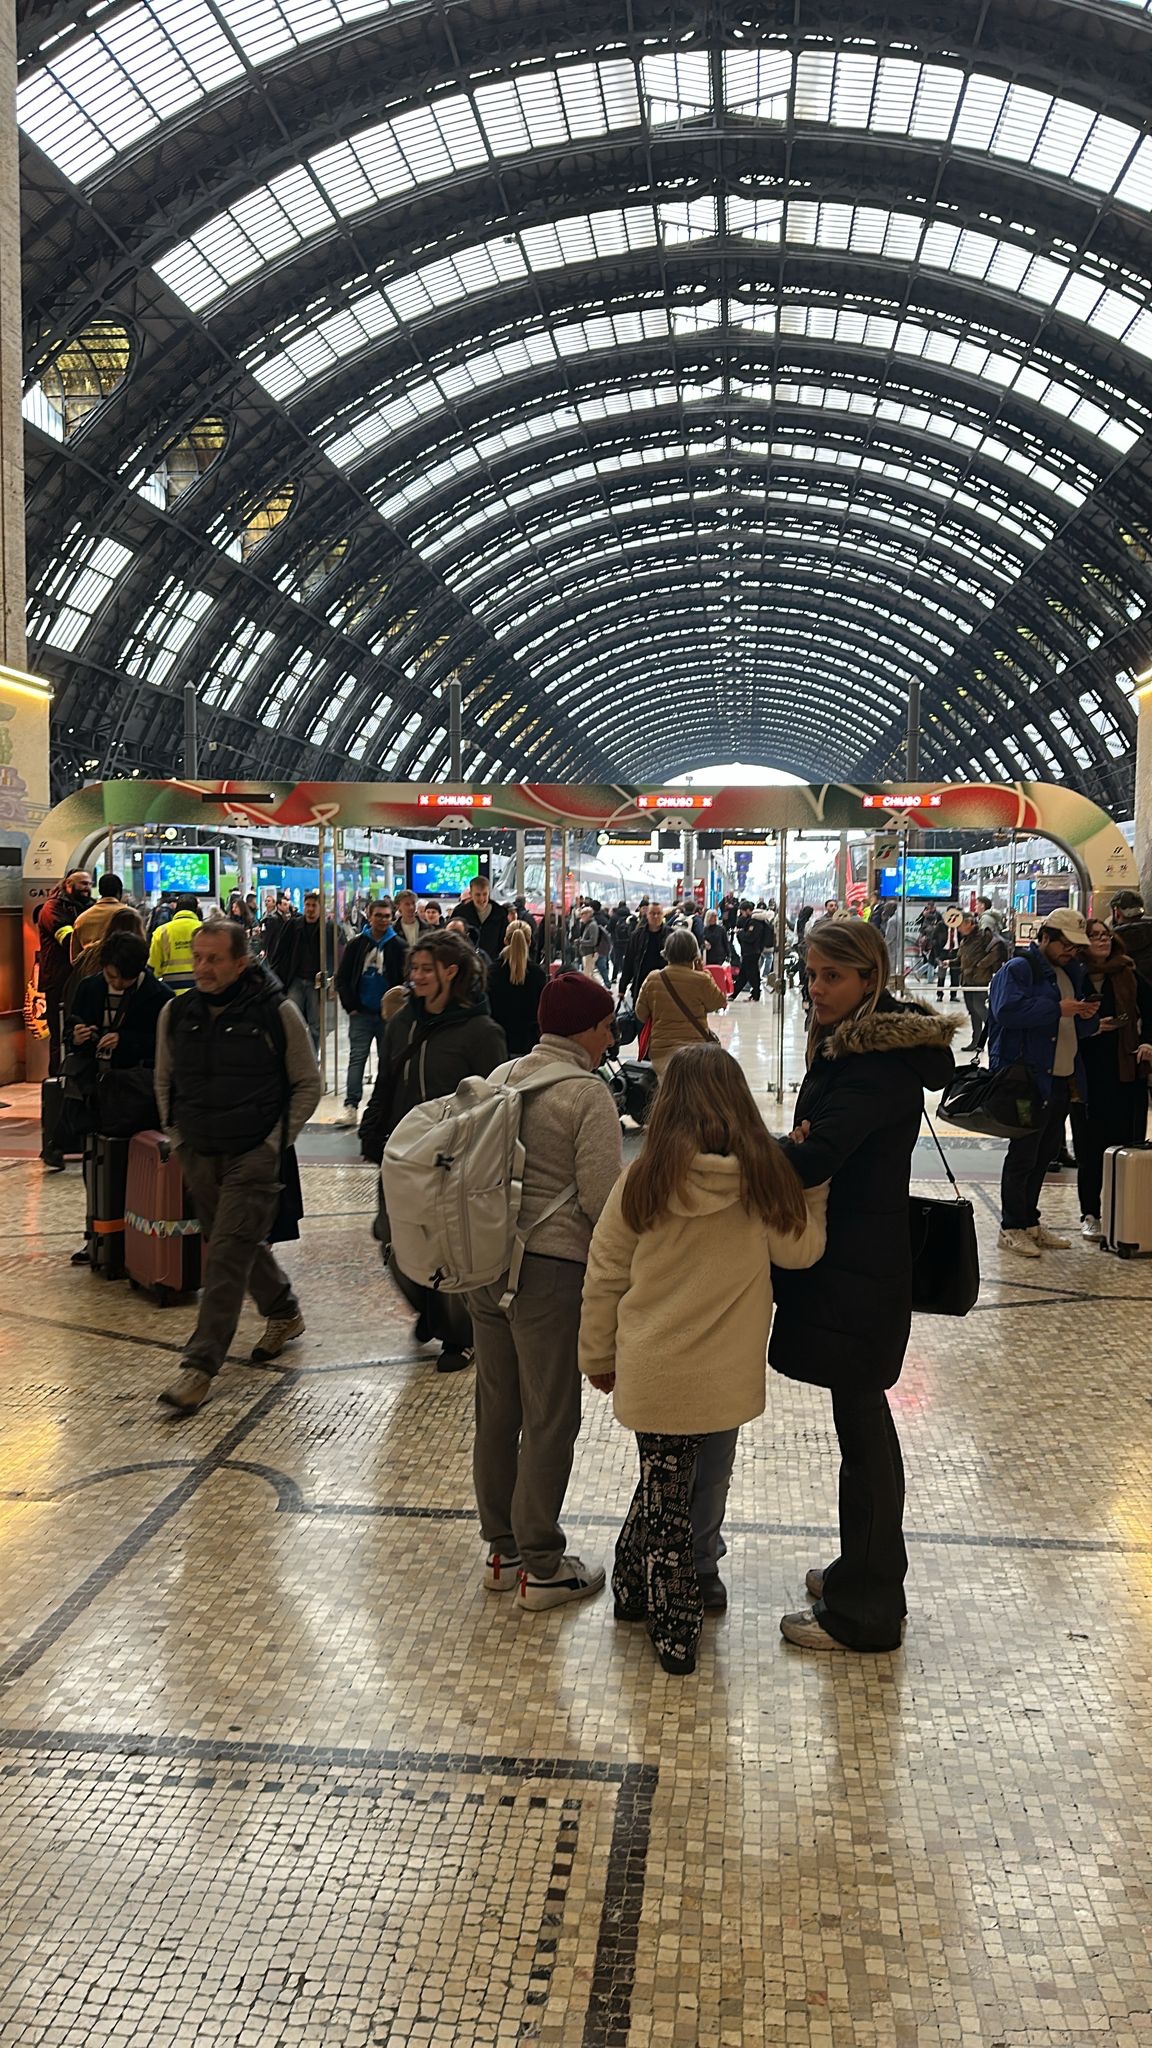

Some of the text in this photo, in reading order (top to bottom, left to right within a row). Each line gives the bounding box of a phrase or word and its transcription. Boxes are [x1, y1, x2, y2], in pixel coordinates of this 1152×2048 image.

[437, 795, 474, 806] CHIUSO
[656, 797, 694, 807] CHIUSO
[882, 796, 921, 807] CHIUSO
[29, 888, 52, 898] GAT
